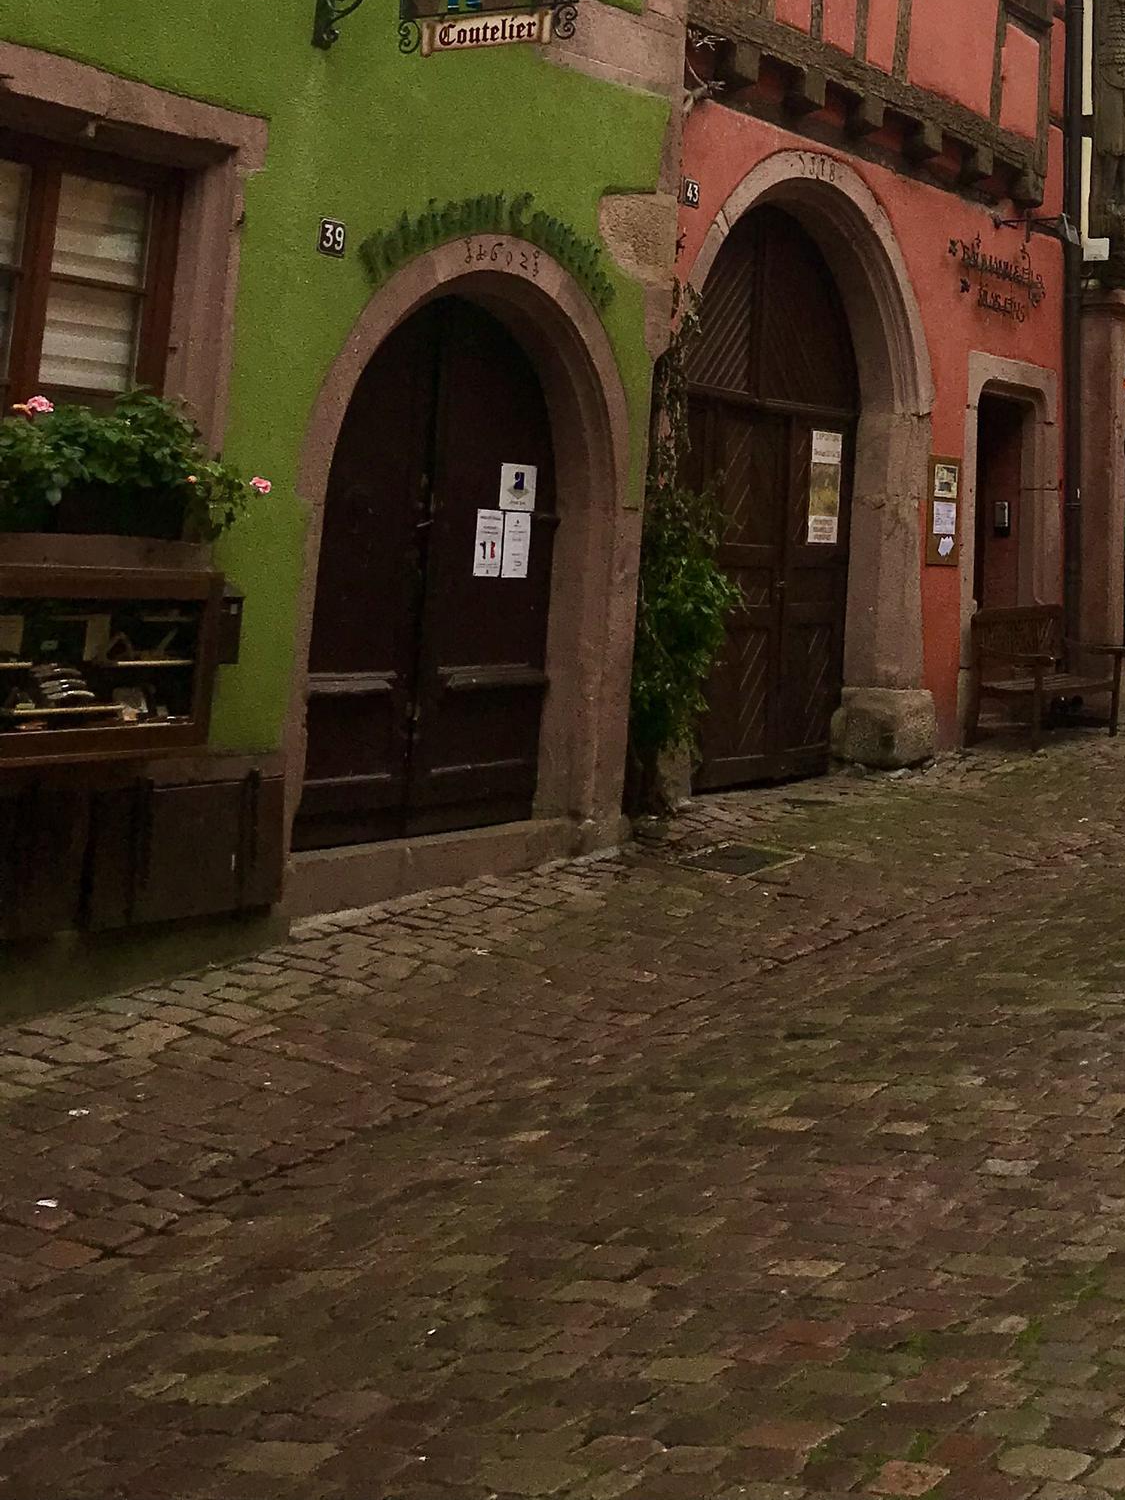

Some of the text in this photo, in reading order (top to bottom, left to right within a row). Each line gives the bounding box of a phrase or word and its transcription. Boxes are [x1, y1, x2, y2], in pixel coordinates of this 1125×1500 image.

[438, 16, 537, 47] Coutelier
[686, 183, 699, 203] 43
[322, 223, 345, 251] 39
